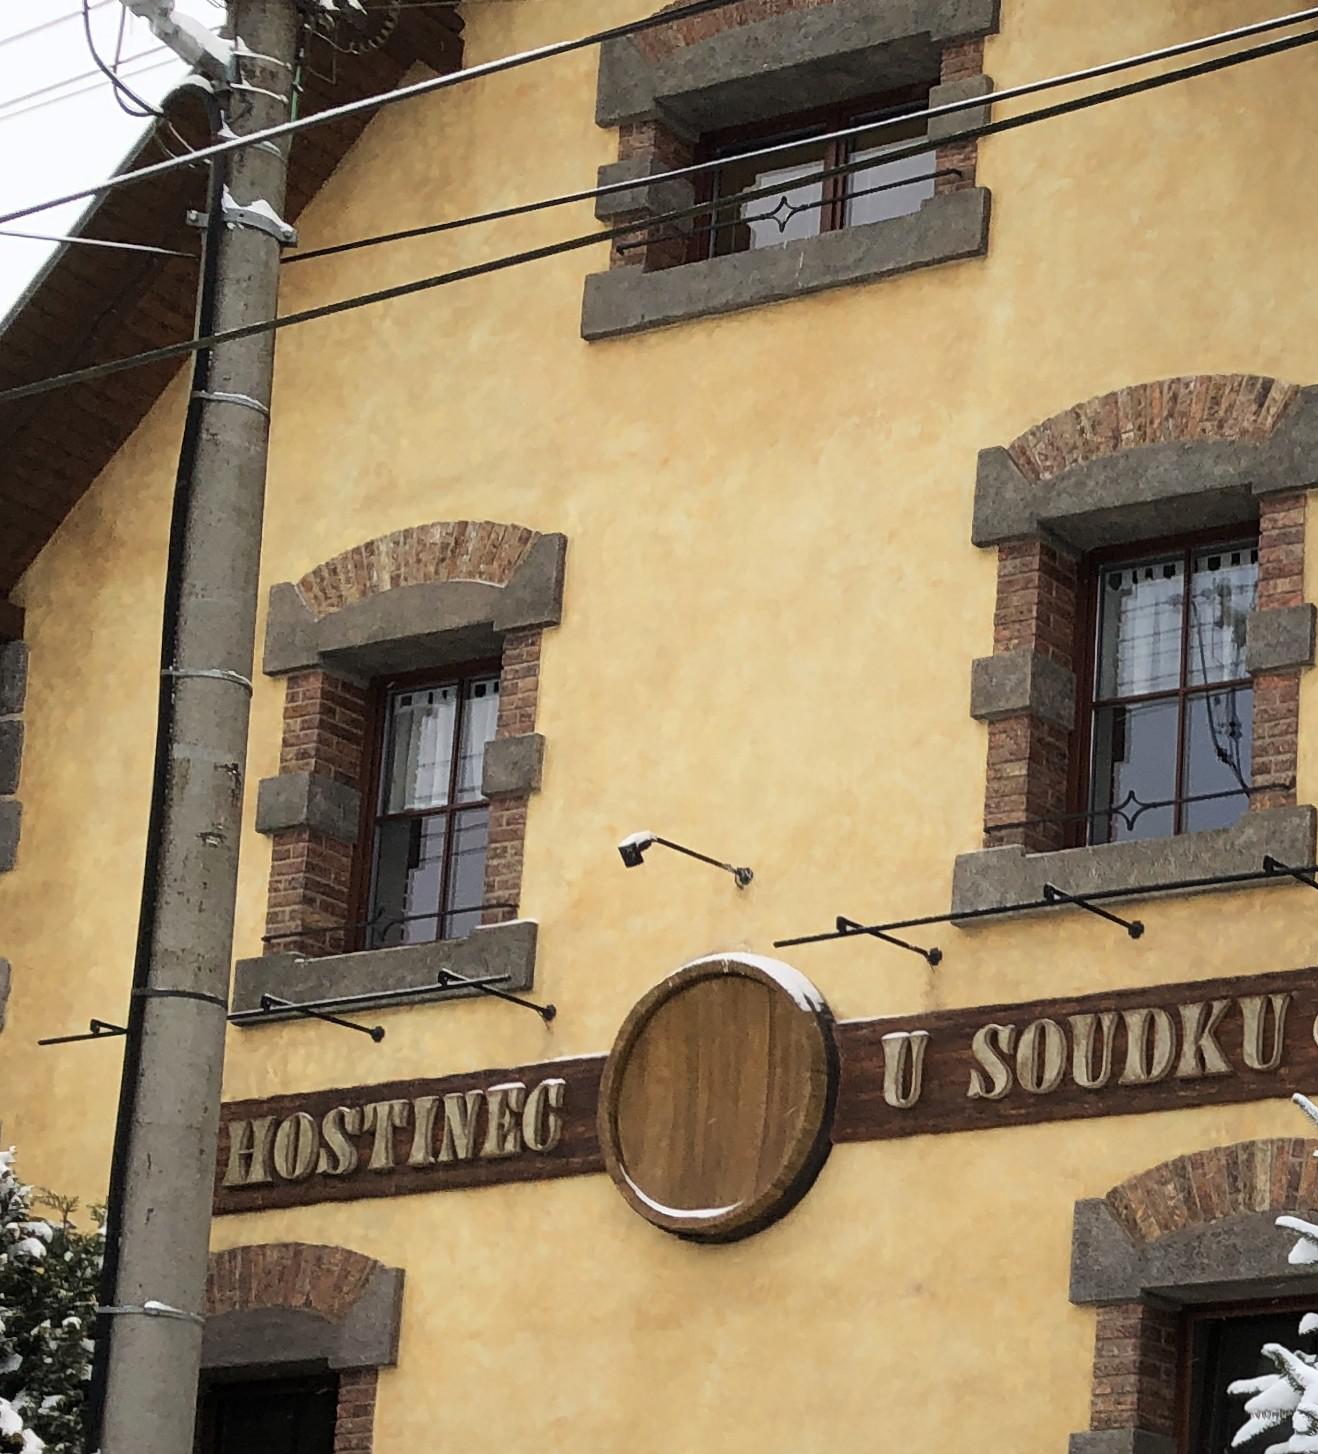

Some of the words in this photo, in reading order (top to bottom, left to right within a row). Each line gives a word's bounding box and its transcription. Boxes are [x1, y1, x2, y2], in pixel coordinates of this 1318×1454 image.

[223, 1078, 567, 1187] HOSTINEC
[880, 1030, 931, 1109] U
[967, 993, 1296, 1100] SOUDKU
